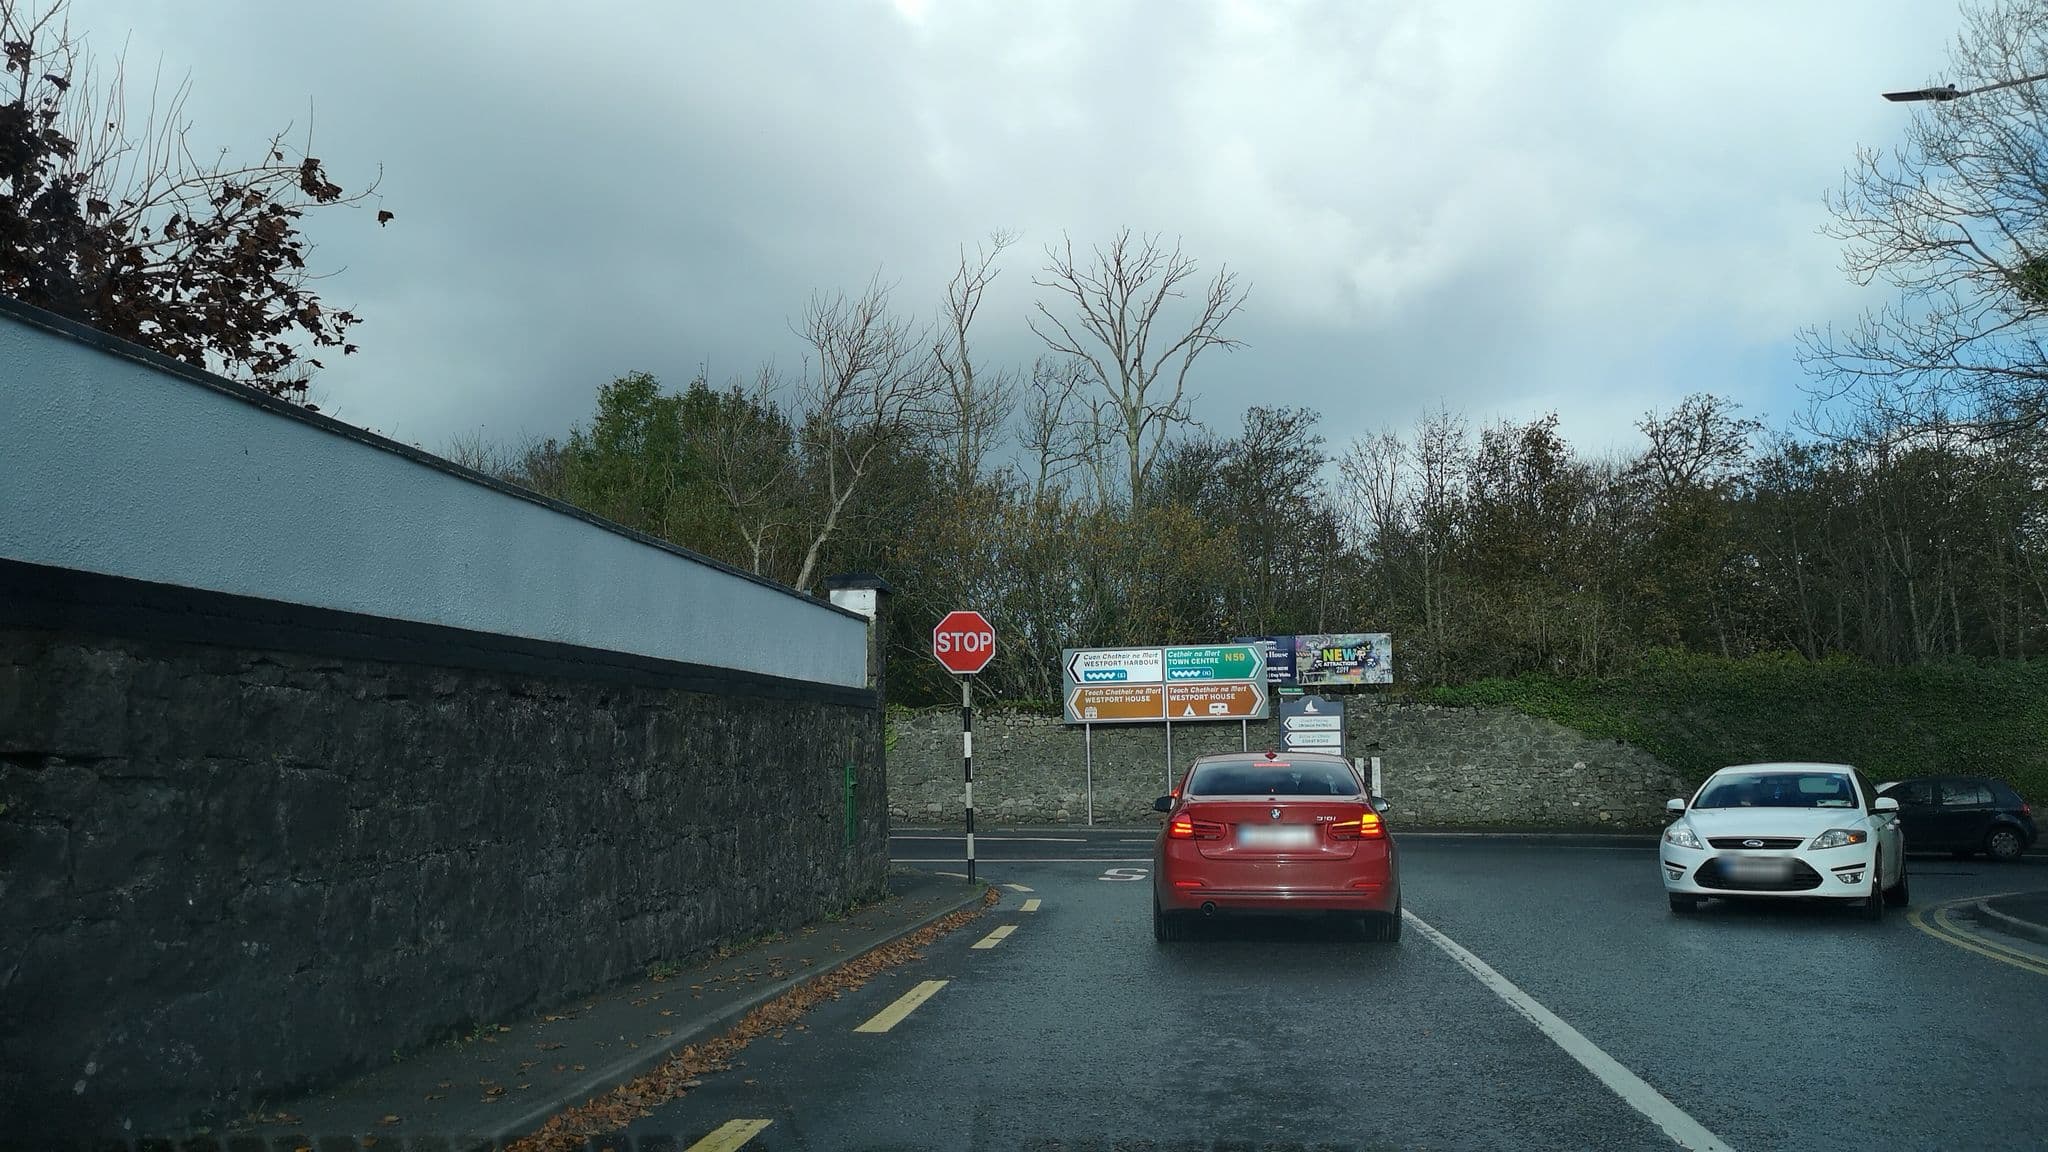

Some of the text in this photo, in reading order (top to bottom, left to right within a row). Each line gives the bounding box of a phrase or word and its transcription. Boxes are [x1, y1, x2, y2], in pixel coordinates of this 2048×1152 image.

[937, 632, 992, 652] STOP
[1225, 652, 1246, 662] N59
[1323, 649, 1356, 661] NEW
